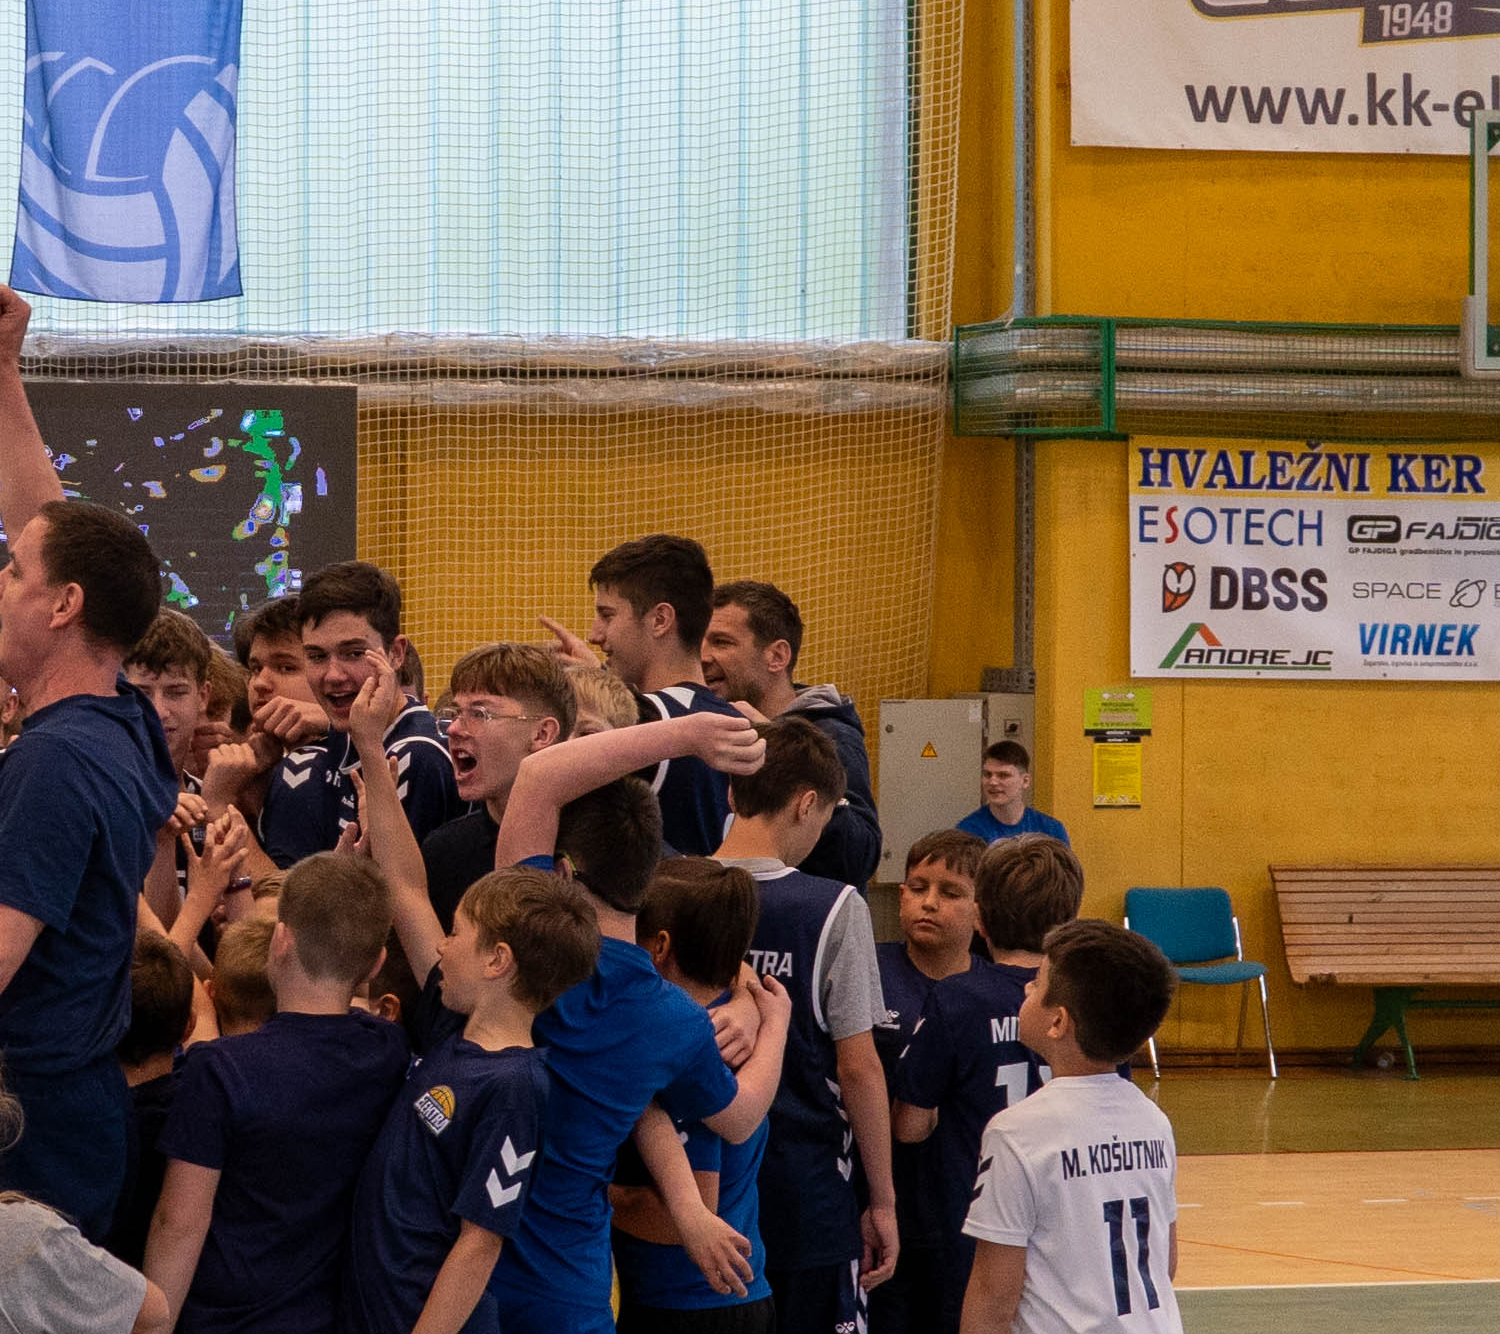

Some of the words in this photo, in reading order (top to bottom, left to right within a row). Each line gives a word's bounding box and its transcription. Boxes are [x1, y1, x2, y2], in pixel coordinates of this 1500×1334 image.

[1378, 0, 1455, 39] 1948
[1137, 440, 1372, 494] HVALEŽNI
[1386, 452, 1487, 495] KER
[1138, 504, 1324, 547] ESOTECH
[1350, 519, 1397, 540] GP
[1209, 565, 1329, 613] DBSS
[1352, 581, 1443, 600] SPACE
[1183, 648, 1334, 667] ANDREJC
[1358, 622, 1482, 657] VIRNEK
[1060, 1147, 1087, 1181] M.
[1087, 1134, 1169, 1176] KOŠUTNIK
[1102, 1195, 1161, 1317] 11
